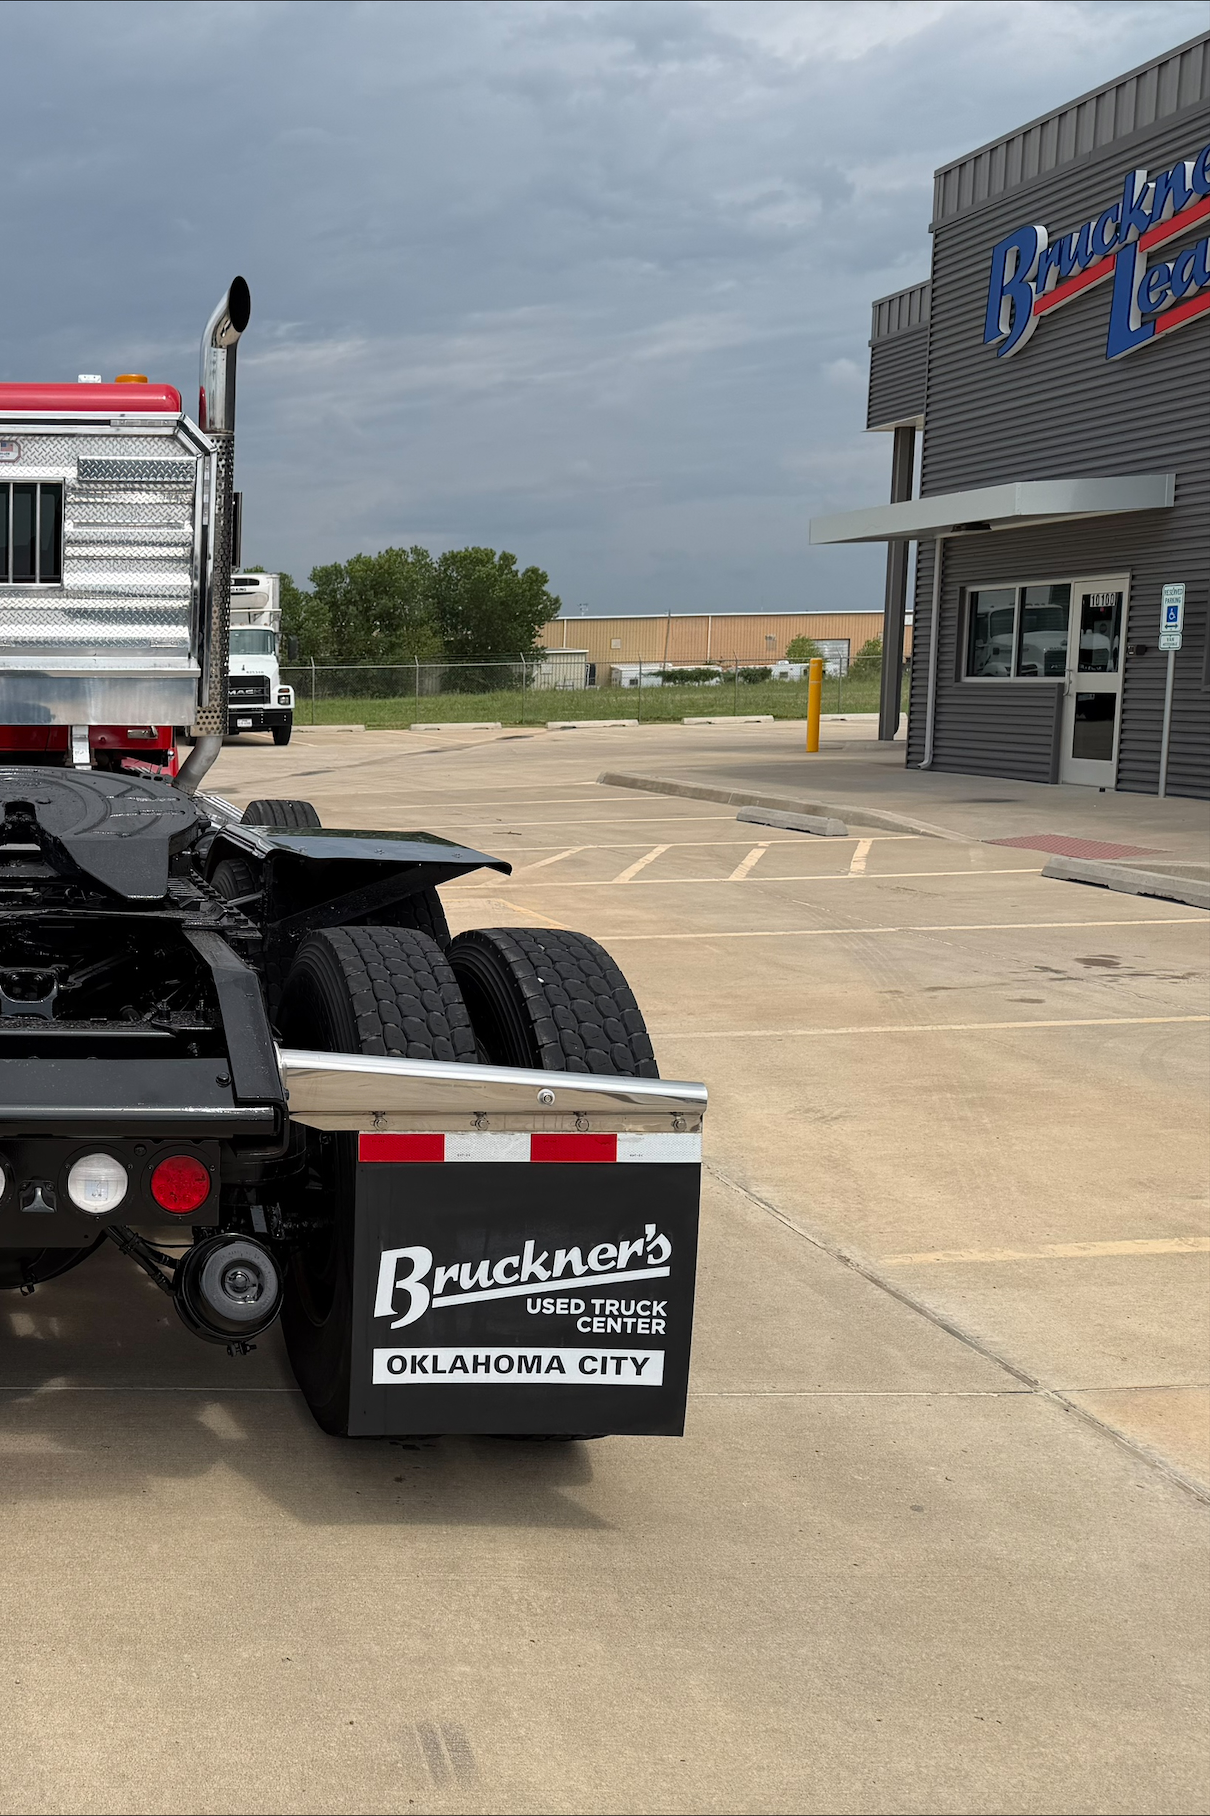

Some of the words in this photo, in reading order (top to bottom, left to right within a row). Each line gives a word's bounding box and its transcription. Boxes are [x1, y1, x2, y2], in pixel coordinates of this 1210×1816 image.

[1091, 593, 1115, 607] 10100
[1165, 596, 1181, 604] PARKING
[373, 1222, 672, 1331] Bruckner's
[526, 1297, 586, 1315] USED
[591, 1298, 668, 1317] TRUCK
[576, 1316, 666, 1335] CENTER
[386, 1354, 566, 1375] OKLAHOMA
[578, 1355, 650, 1376] CITY
